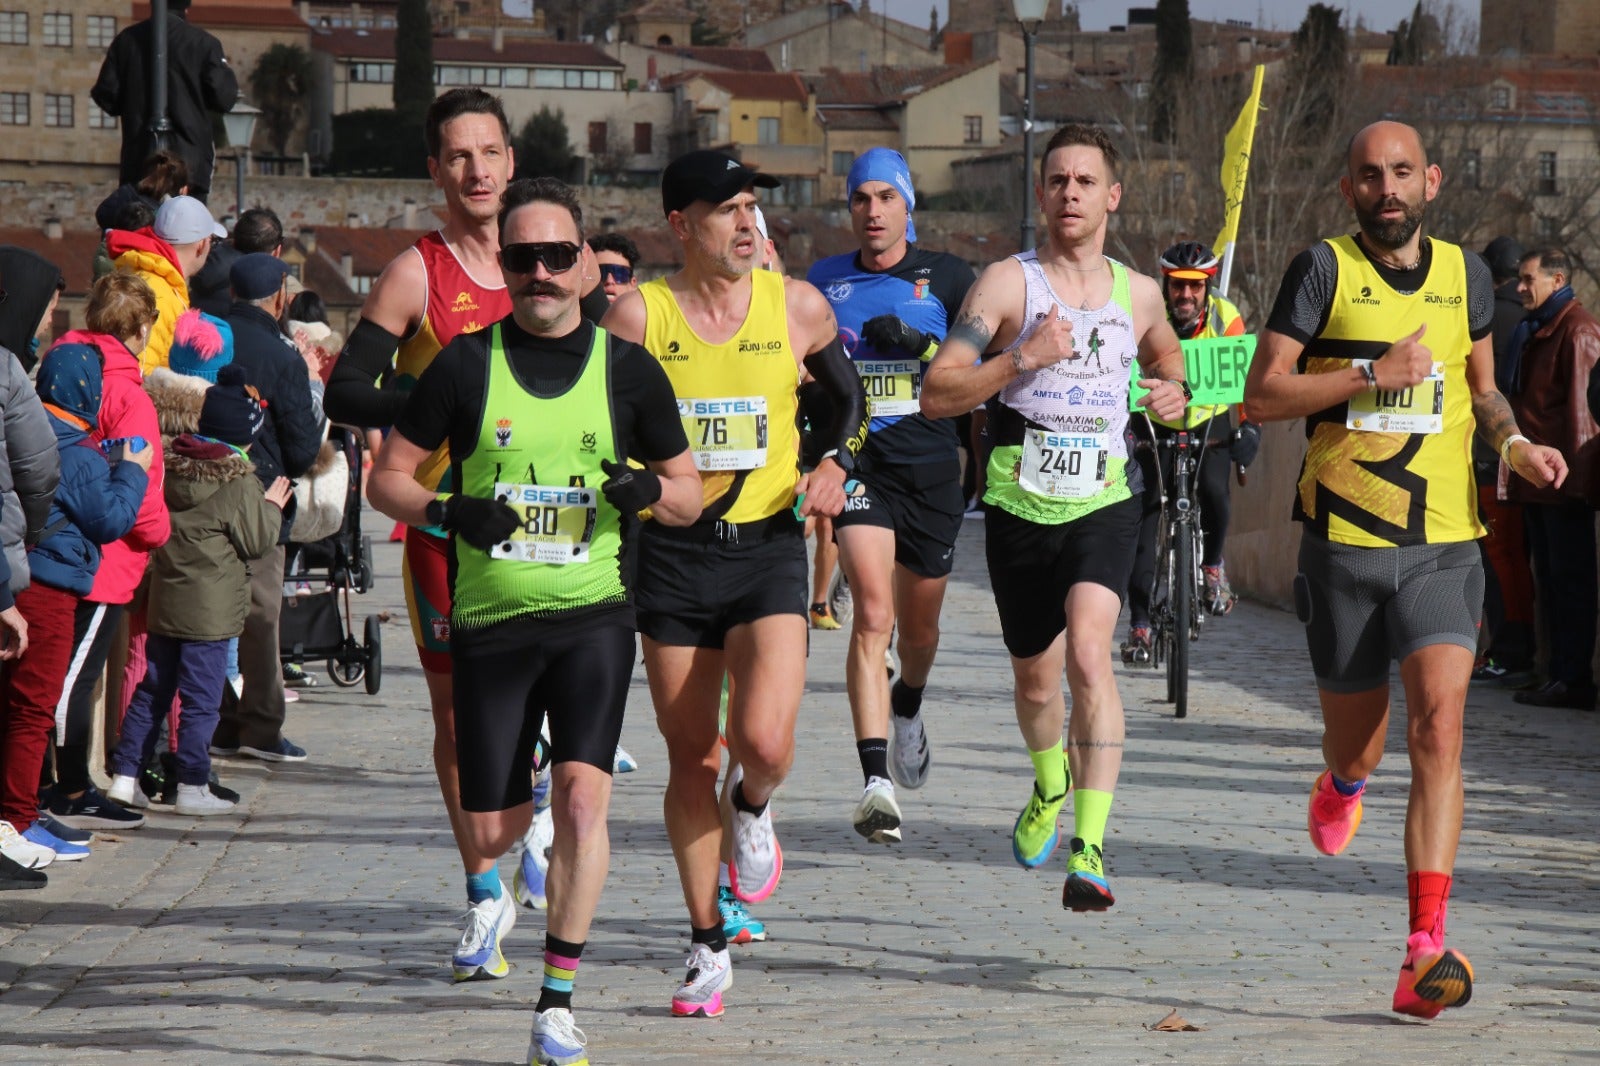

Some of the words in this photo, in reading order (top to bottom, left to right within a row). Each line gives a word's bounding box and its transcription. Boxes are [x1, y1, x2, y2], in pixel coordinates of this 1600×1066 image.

[1351, 297, 1381, 306] VIATOR
[1424, 295, 1443, 304] RUN
[1449, 296, 1462, 304] GO
[738, 343, 760, 353] RUN
[767, 341, 782, 350] GO
[659, 354, 690, 362] VIATOR
[864, 362, 913, 373] SETEL
[1185, 345, 1248, 391] UJER
[862, 375, 896, 397] 200
[1032, 389, 1064, 400] AMTEL
[1092, 390, 1114, 398] AZUL
[694, 401, 757, 415] SETEL
[1086, 399, 1117, 407] TELECO
[1032, 411, 1104, 426] SANMAXIMO
[697, 417, 728, 446] 76
[1057, 423, 1098, 433] TELECOM
[1046, 436, 1101, 448] SETEL
[1039, 448, 1082, 475] 240
[844, 496, 870, 512] MSC
[524, 505, 559, 536] 80
